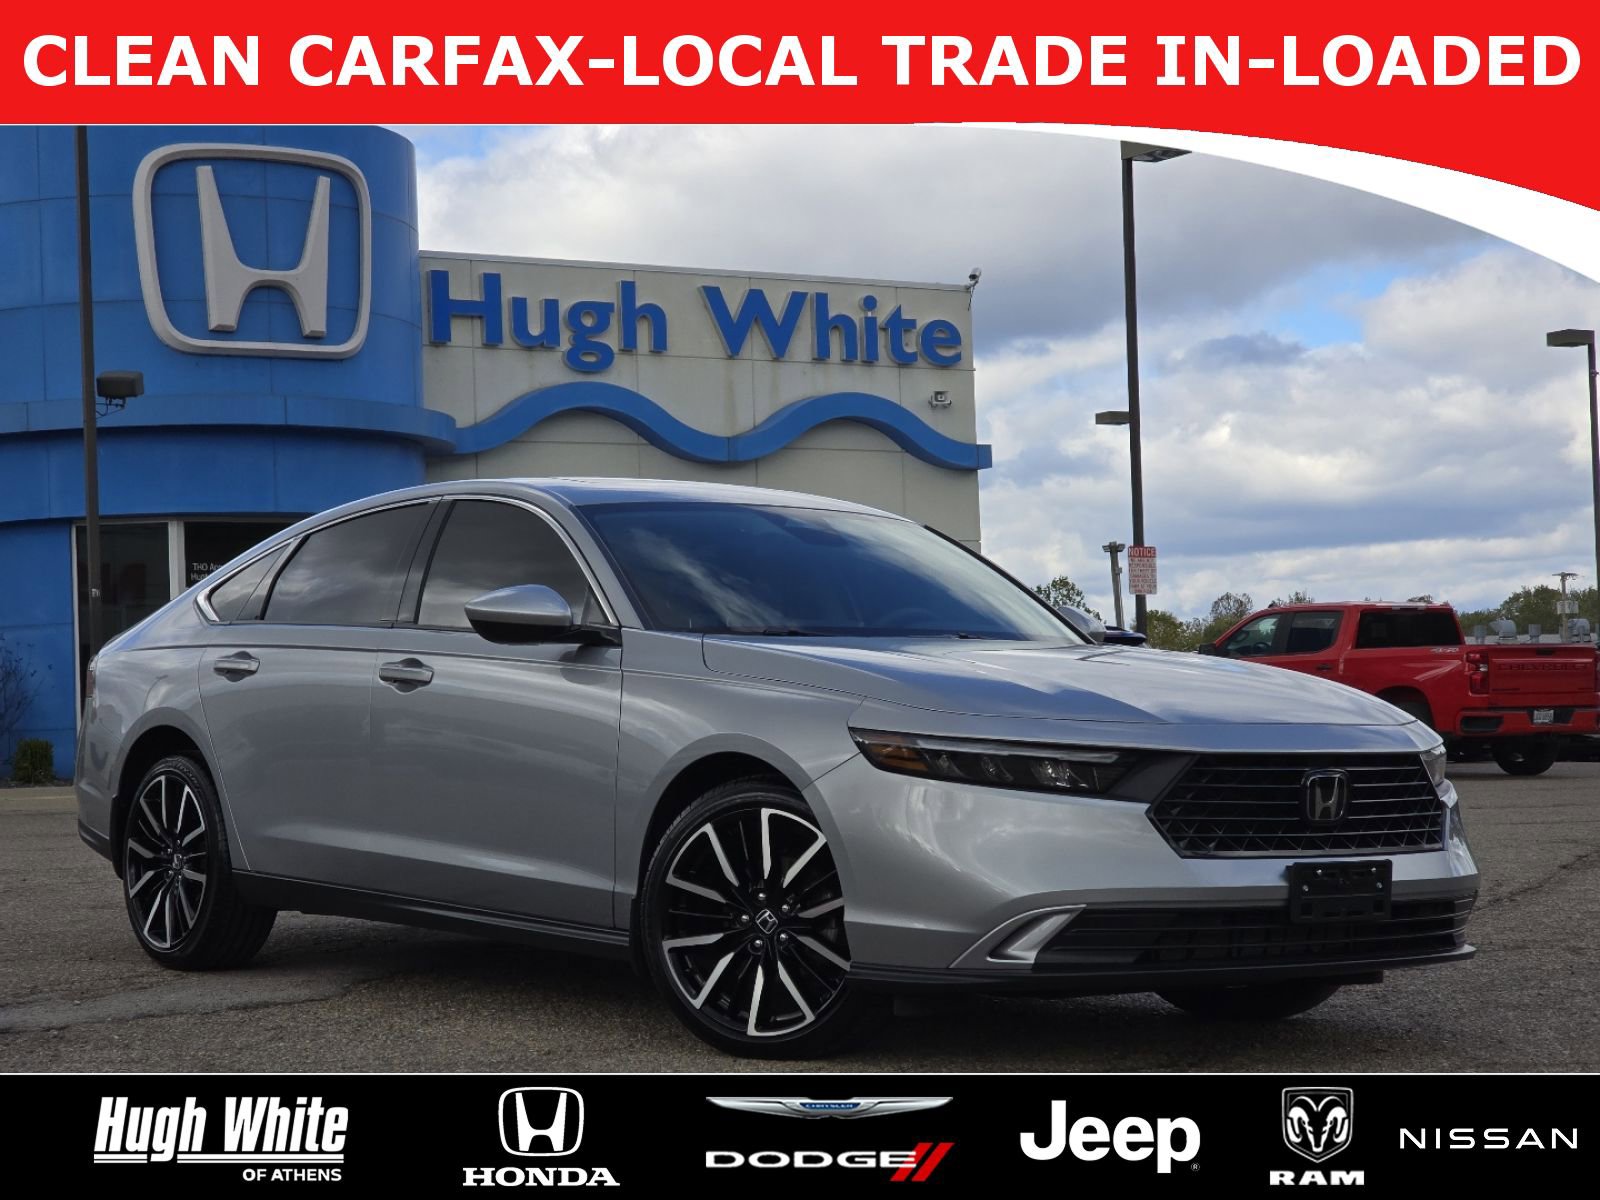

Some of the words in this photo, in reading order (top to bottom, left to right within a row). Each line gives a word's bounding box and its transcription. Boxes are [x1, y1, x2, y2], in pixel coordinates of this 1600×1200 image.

[428, 269, 667, 372] Hugh
[701, 285, 962, 366] White
[1128, 547, 1156, 557] NOTICE
